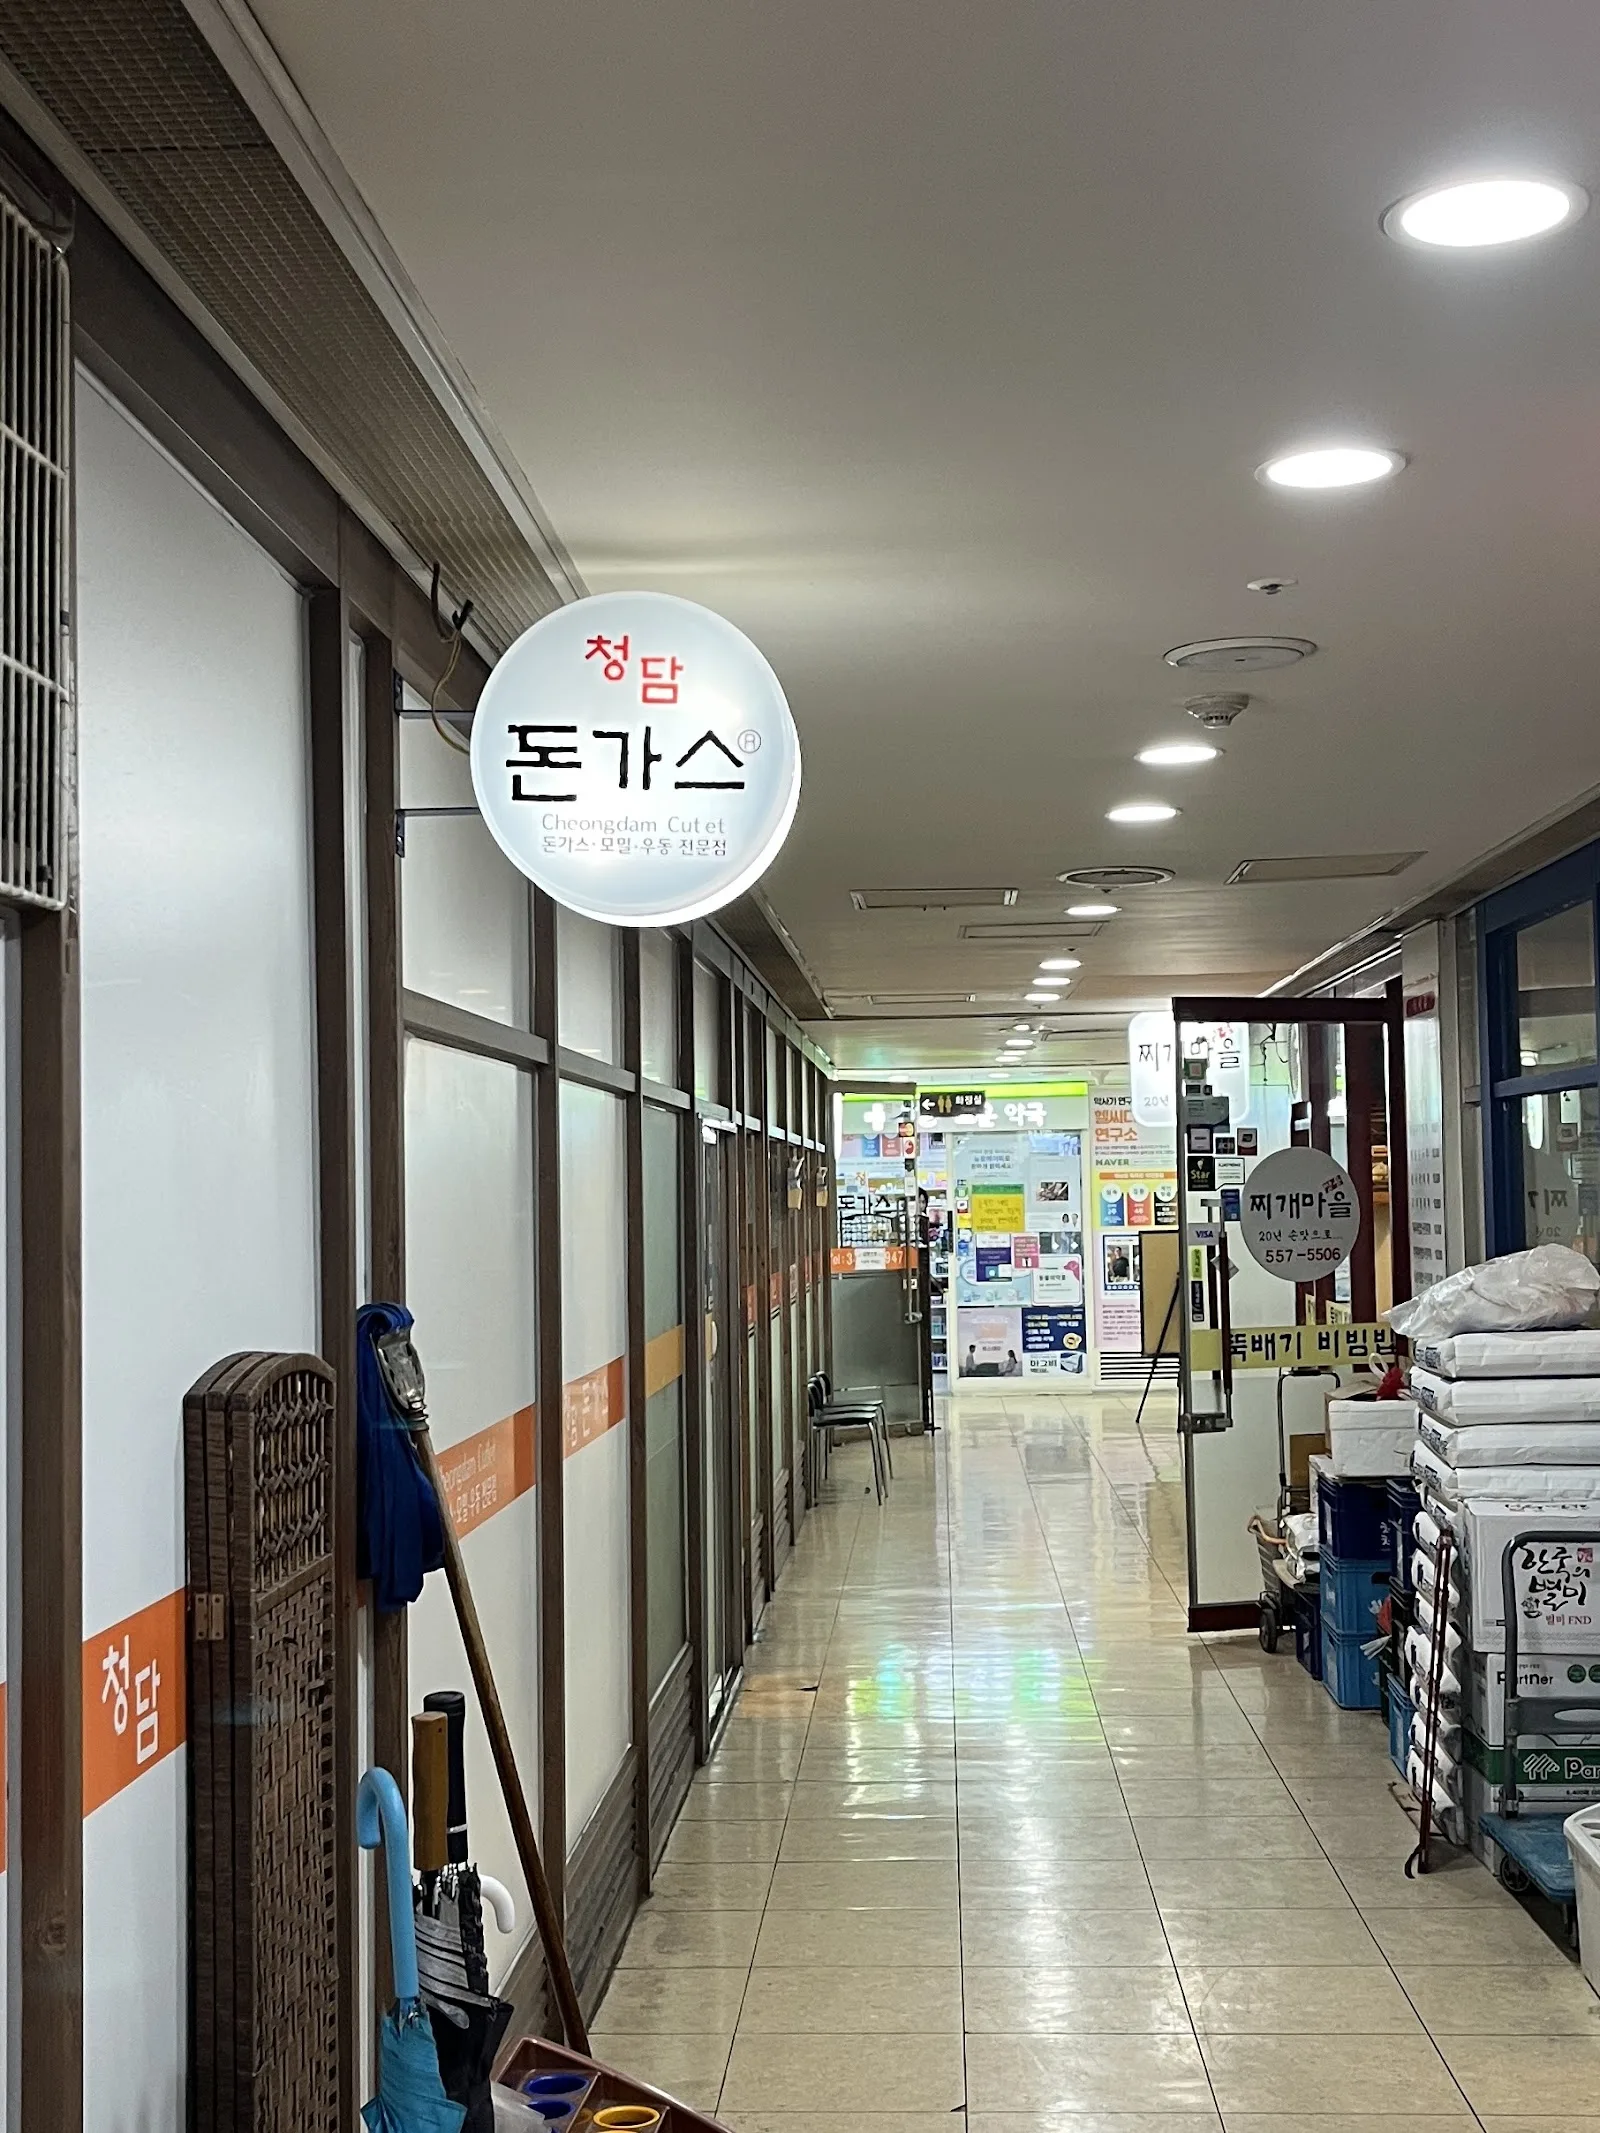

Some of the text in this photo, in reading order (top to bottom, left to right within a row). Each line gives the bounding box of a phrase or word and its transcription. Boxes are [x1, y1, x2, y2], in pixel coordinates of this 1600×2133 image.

[585, 634, 684, 704] 청담
[505, 725, 745, 802] 돈가스
[542, 813, 657, 835] Cheongdam
[678, 838, 727, 857] 전문점
[1003, 1101, 1048, 1128] 약국
[1094, 1127, 1139, 1142] 연구소
[1095, 1158, 1130, 1166] NAVER
[1190, 1169, 1210, 1180] Star
[1250, 1191, 1352, 1220] 찌개마을
[1195, 1230, 1214, 1239] VISA
[1258, 1229, 1283, 1242] 20년
[1265, 1247, 1341, 1263] 557-5506
[1318, 1328, 1397, 1359] 비빔밥
[1520, 1545, 1591, 1584] 한국의
[1528, 1575, 1587, 1612] 별미
[1545, 1614, 1592, 1625] 별미 FND
[1496, 1671, 1554, 1686] Prtner
[101, 1634, 161, 1765] 청담
